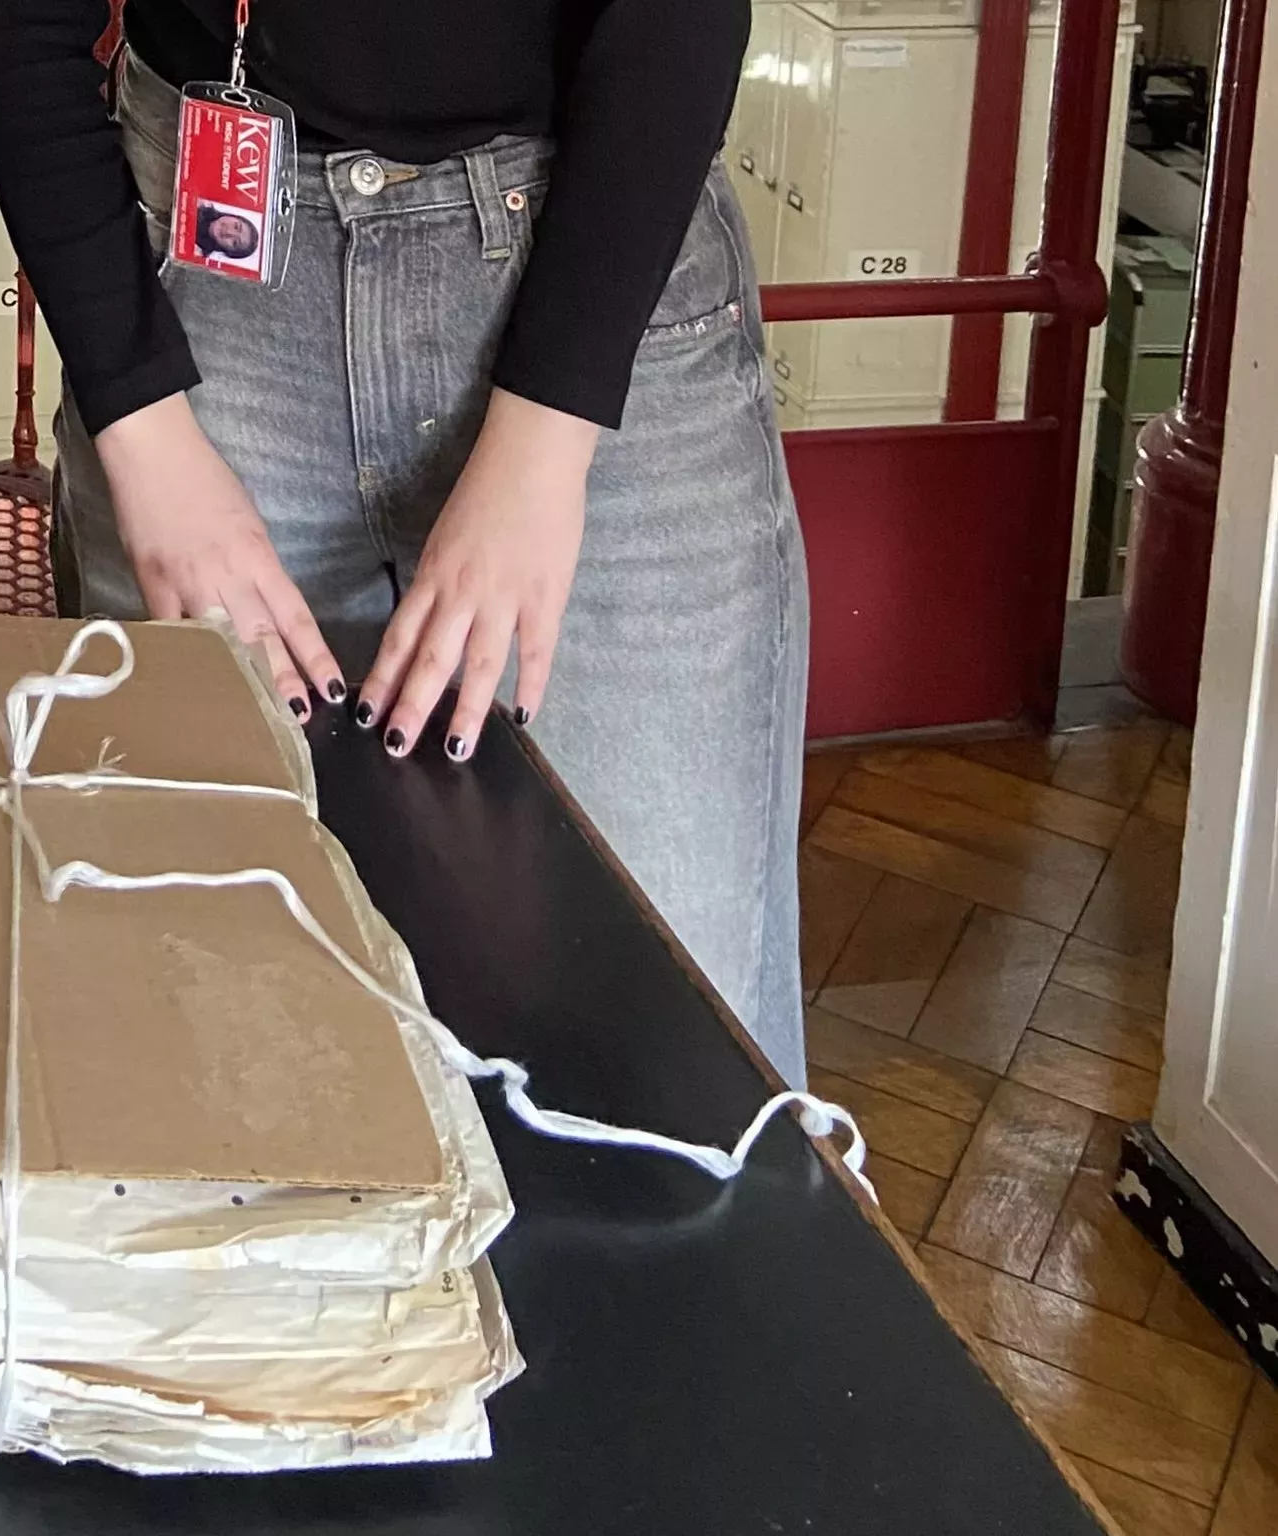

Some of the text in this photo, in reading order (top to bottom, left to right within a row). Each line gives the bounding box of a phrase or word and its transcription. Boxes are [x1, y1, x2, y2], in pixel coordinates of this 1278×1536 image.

[235, 114, 271, 207] Kew
[860, 256, 907, 275] C 28
